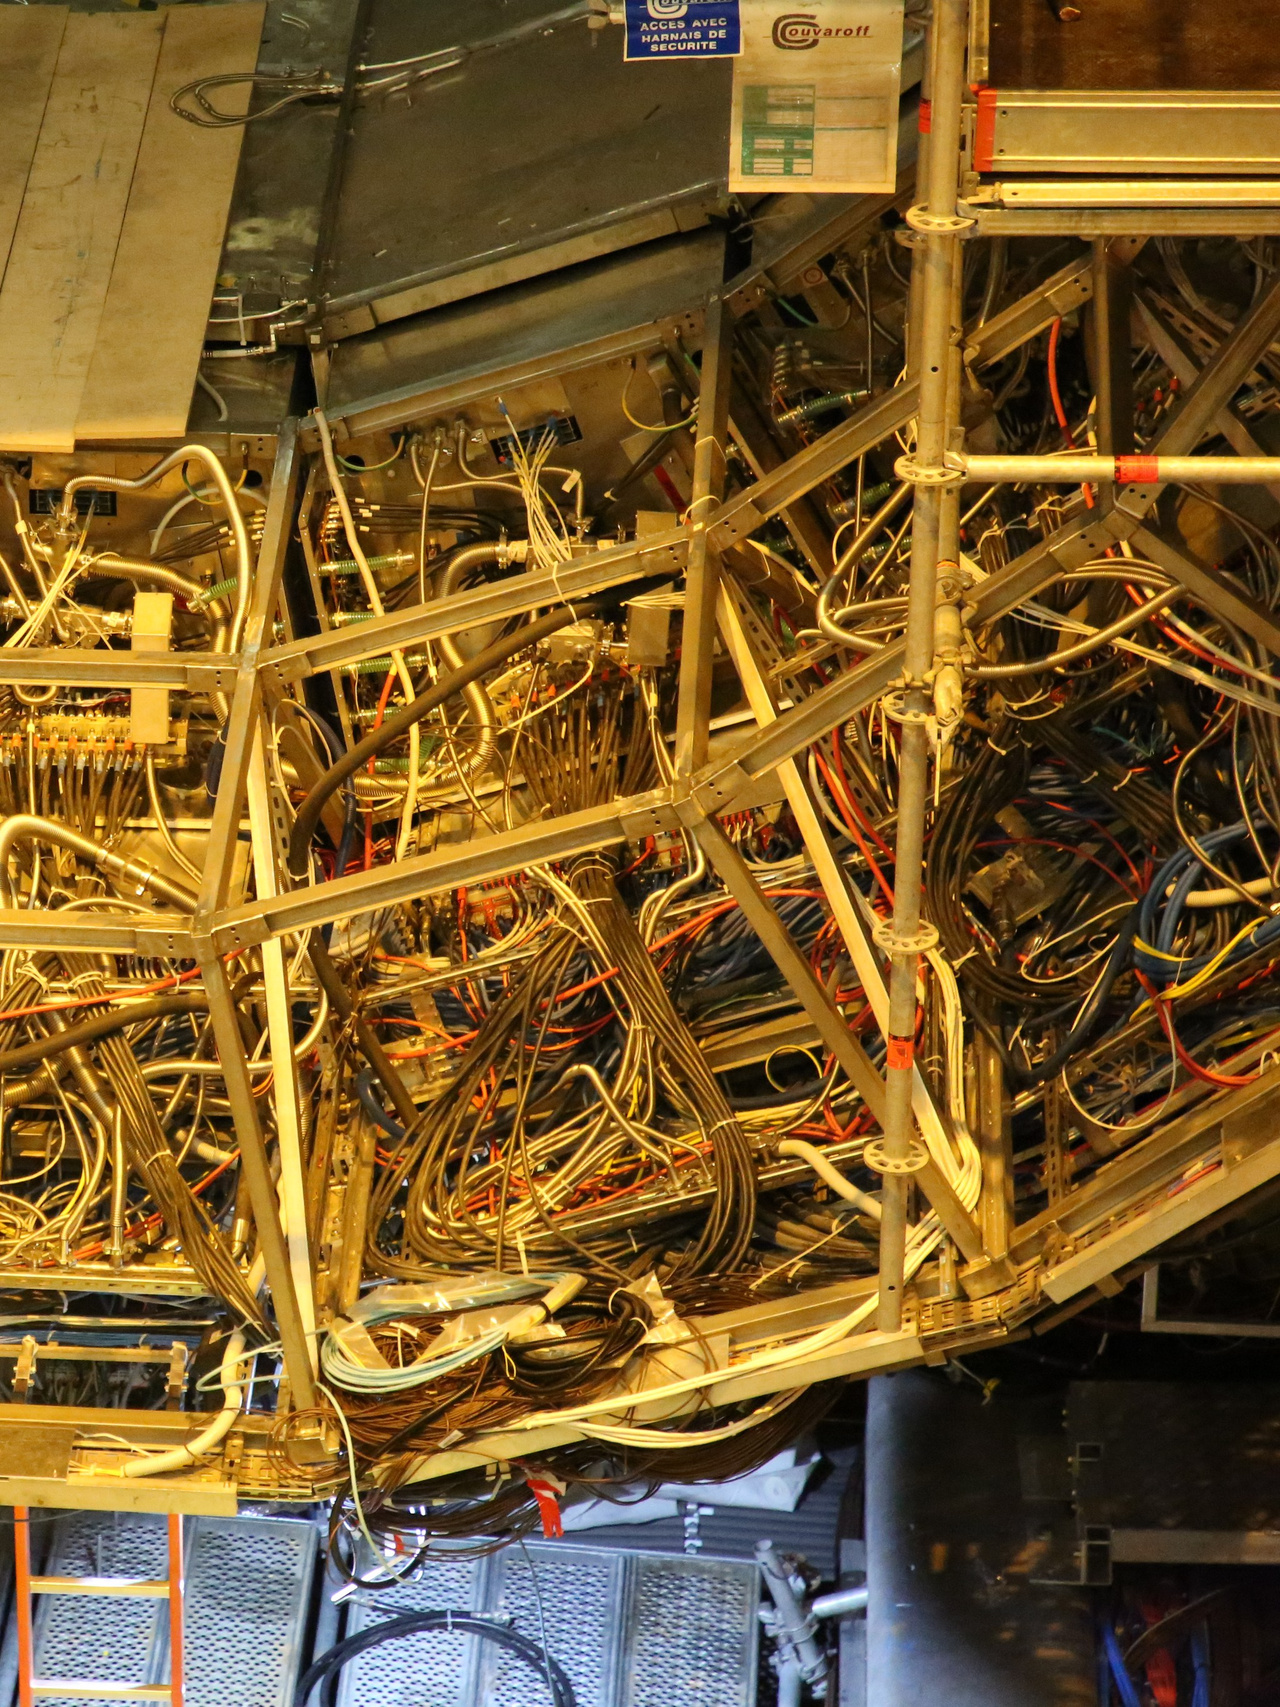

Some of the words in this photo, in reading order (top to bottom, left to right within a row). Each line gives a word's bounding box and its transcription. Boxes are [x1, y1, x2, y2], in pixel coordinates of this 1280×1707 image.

[640, 20, 685, 31] ACCES
[692, 18, 727, 28] AVEC
[641, 31, 702, 43] HARNAIS
[708, 30, 727, 39] DE
[772, 13, 870, 50] Couvaroff
[650, 41, 717, 52] SECURITE
